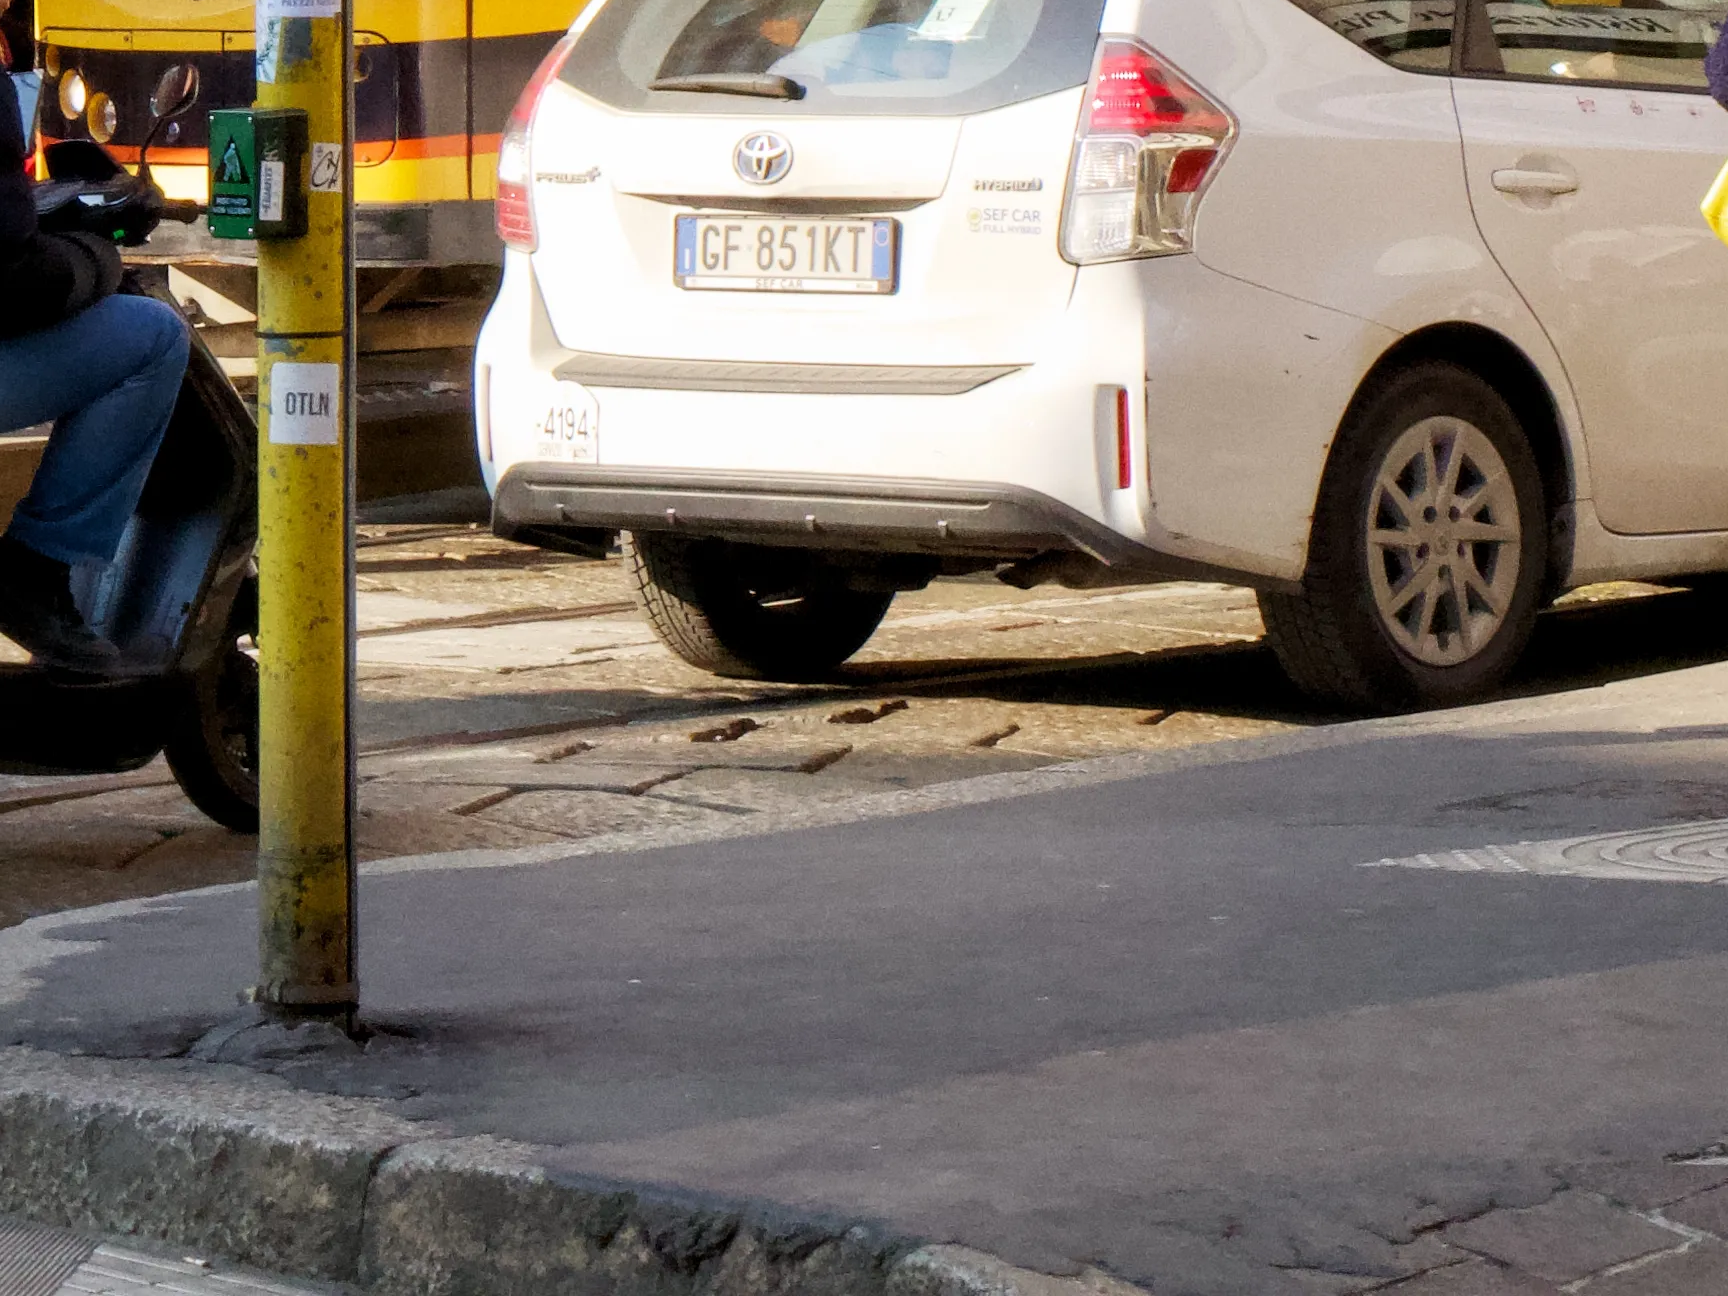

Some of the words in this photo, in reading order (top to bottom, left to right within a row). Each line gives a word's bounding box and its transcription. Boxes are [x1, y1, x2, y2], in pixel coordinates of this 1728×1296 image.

[983, 208, 1009, 222] SEF
[1012, 208, 1042, 223] CAR
[702, 224, 742, 270] GF
[756, 225, 866, 273] 851KT
[755, 278, 777, 289] SEF
[780, 279, 803, 290] CAR
[285, 391, 330, 417] OTLN
[544, 405, 589, 441] 4194
